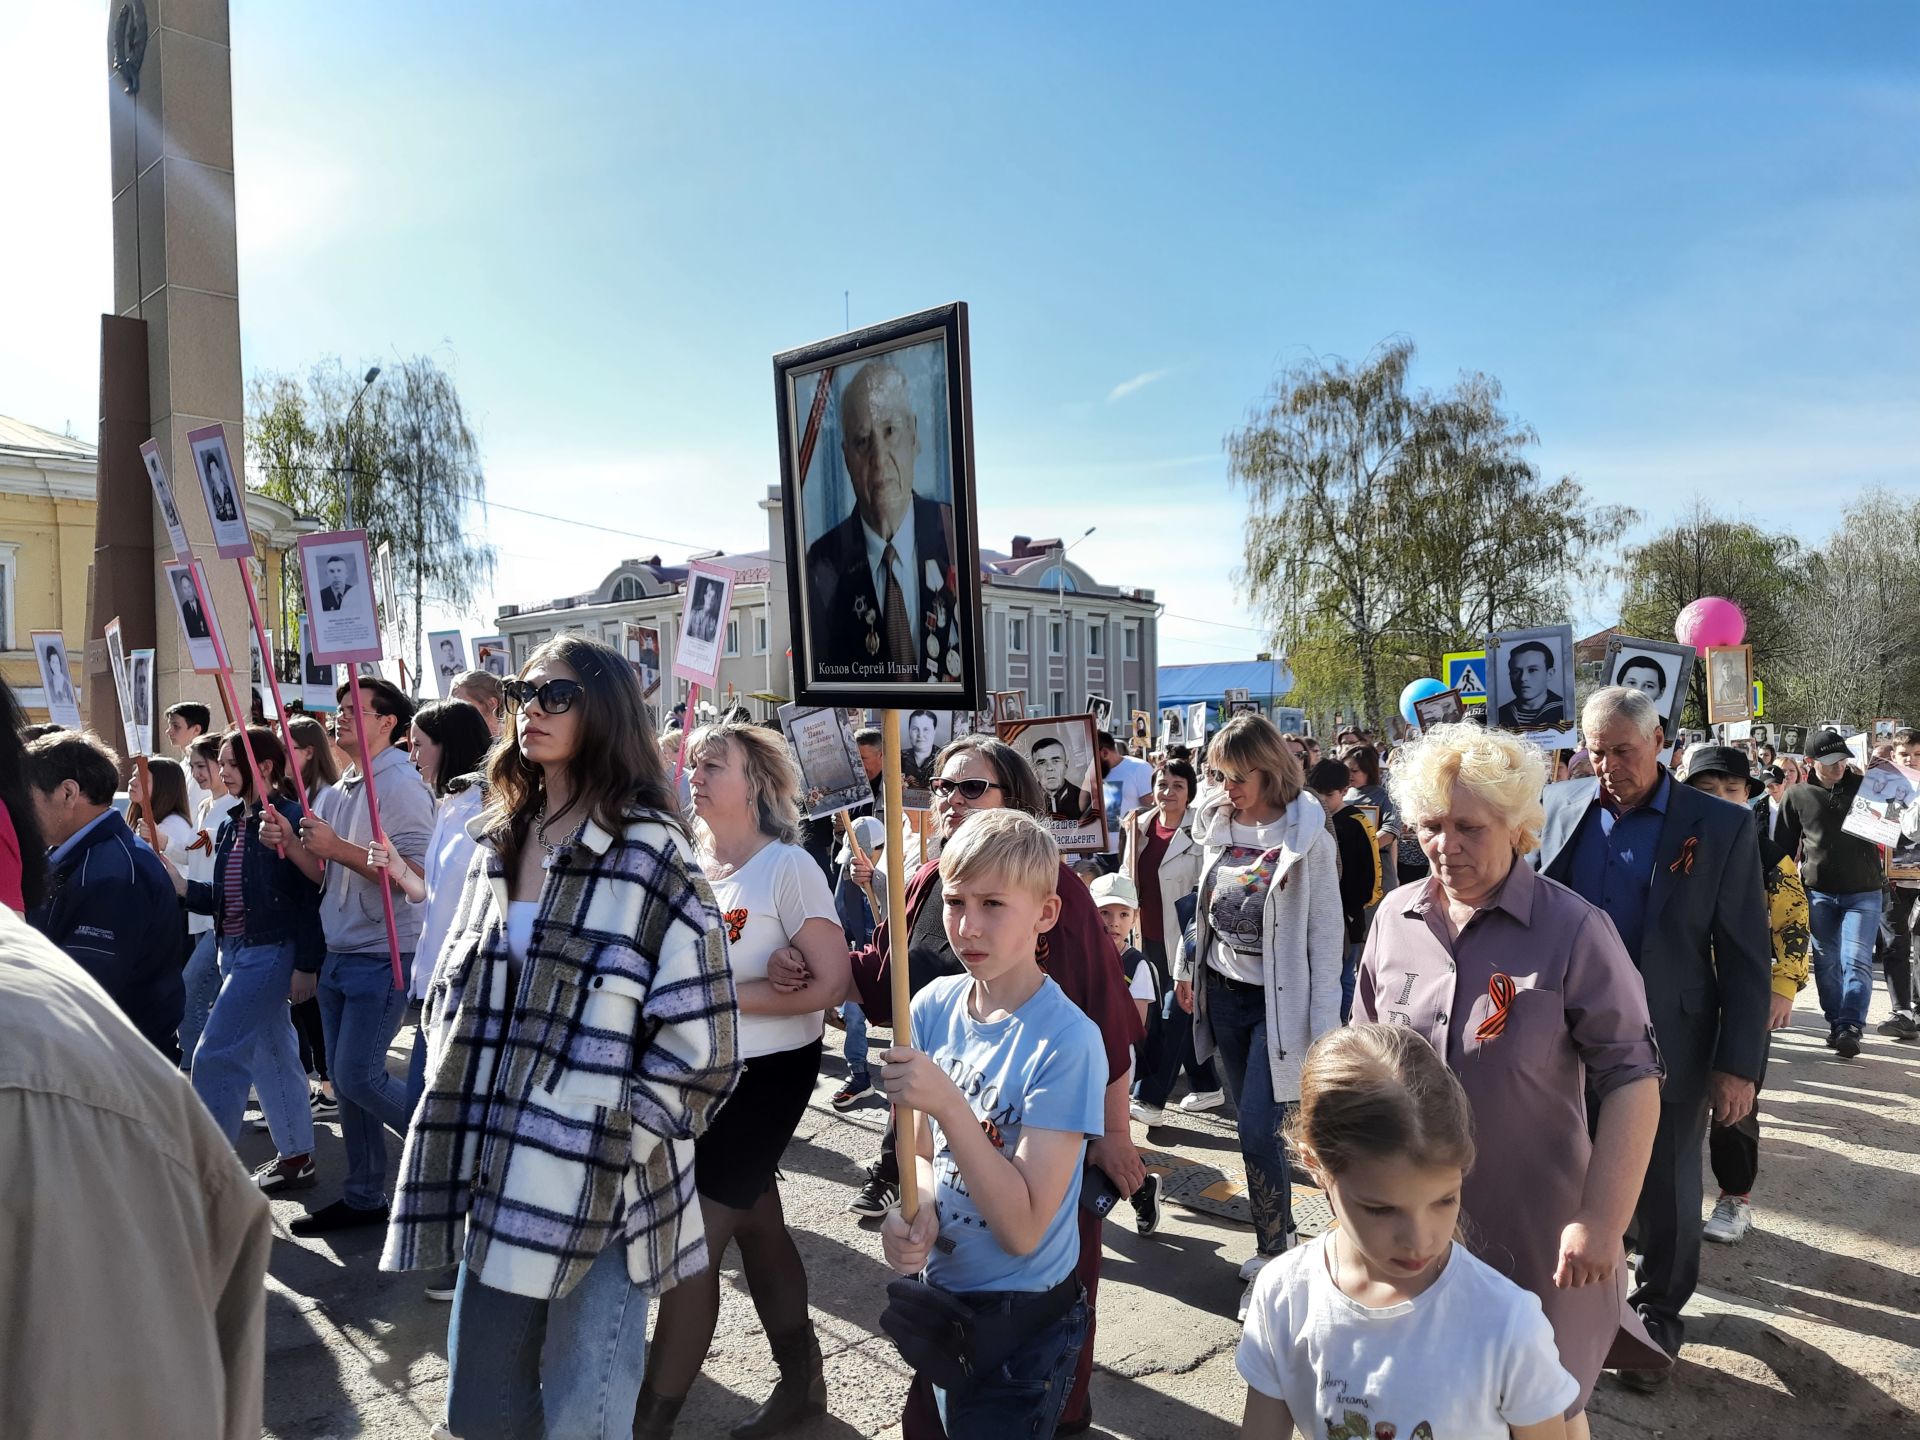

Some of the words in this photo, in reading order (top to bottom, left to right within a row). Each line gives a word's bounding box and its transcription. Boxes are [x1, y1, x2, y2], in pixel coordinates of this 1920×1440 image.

[818, 662, 849, 675] Козлов
[851, 661, 885, 677] Сергей
[887, 661, 920, 679] Ильич
[1336, 1392, 1369, 1409] dreams
